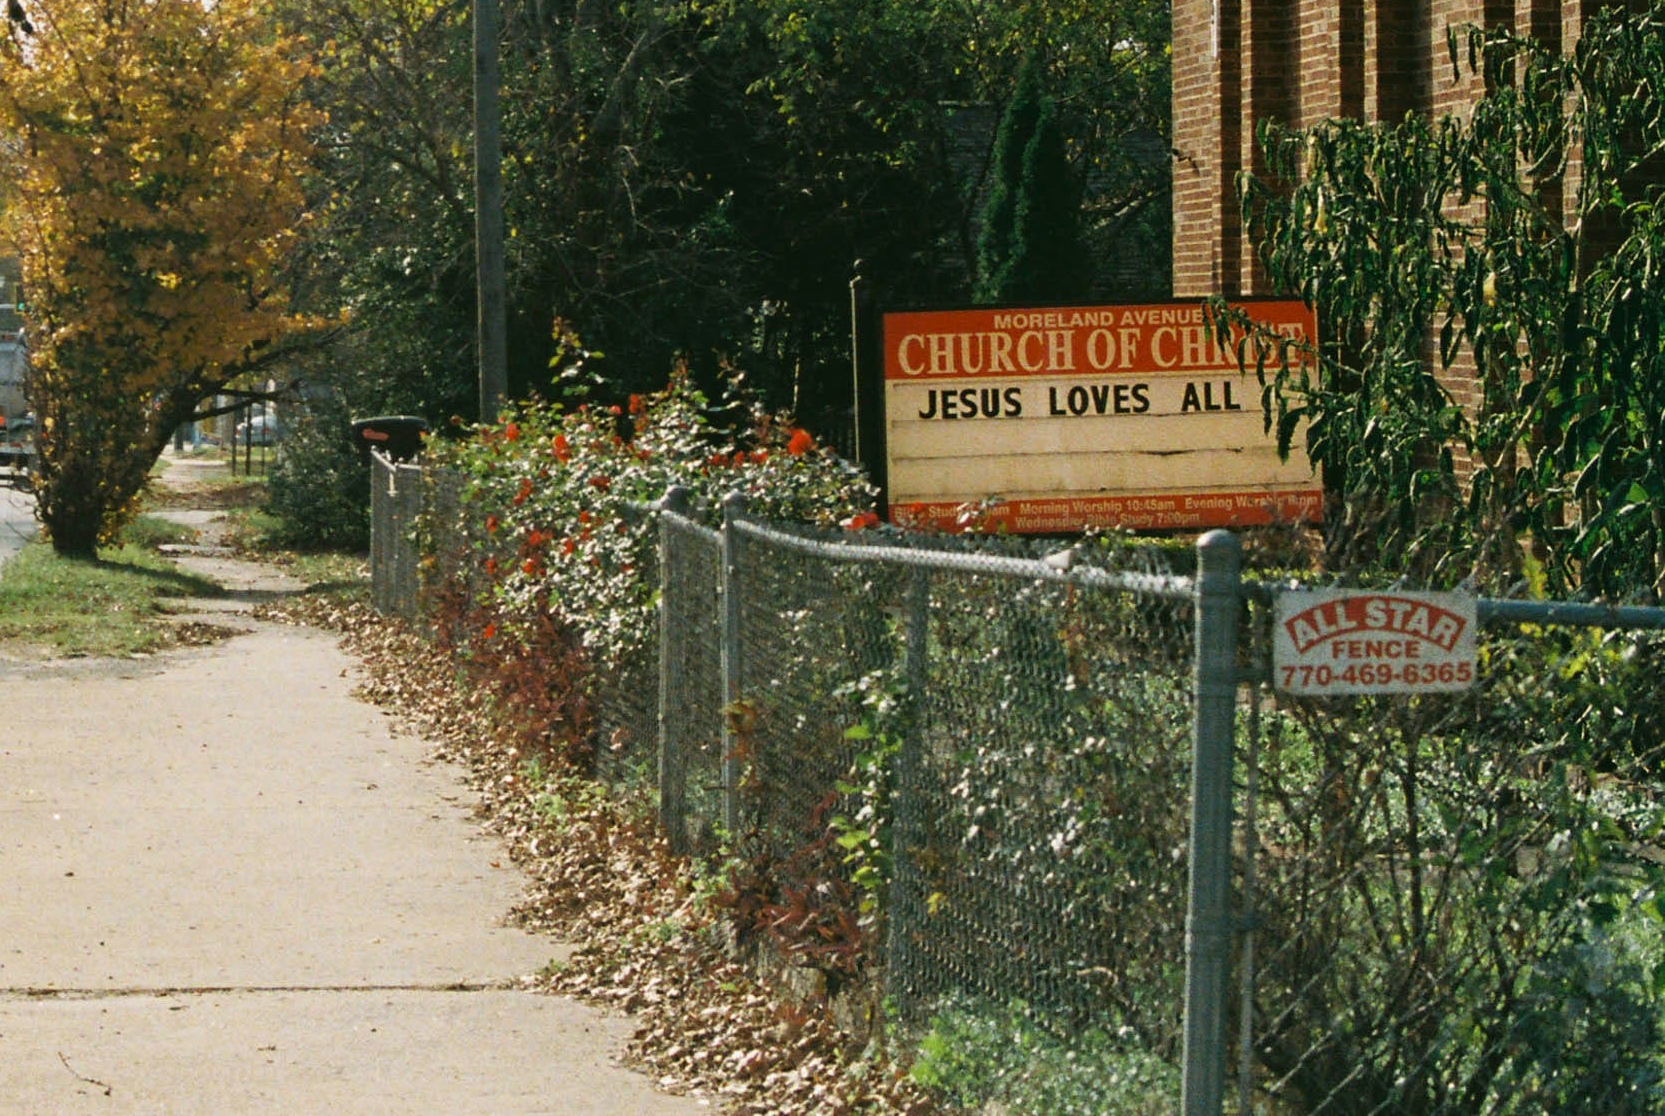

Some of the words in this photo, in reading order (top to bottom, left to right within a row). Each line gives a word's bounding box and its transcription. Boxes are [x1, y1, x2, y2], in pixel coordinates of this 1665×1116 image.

[993, 311, 1114, 330] MORELAND
[1120, 309, 1203, 326] AVENUE
[897, 330, 1075, 376] CHURCH
[1087, 327, 1141, 370] OF
[919, 388, 1023, 420] JESUS
[1049, 384, 1150, 416] LOVES
[1182, 381, 1241, 412] ALL
[1019, 502, 1070, 517] Morning
[1072, 499, 1123, 515] Worship
[1126, 498, 1176, 511] 10:45am
[1185, 496, 1233, 511] Evening
[1119, 512, 1153, 526] Study
[1292, 601, 1357, 648] ALL
[1364, 598, 1459, 647] STAR
[1331, 639, 1421, 659] FENCE
[1280, 661, 1472, 687] 770-469-6365
